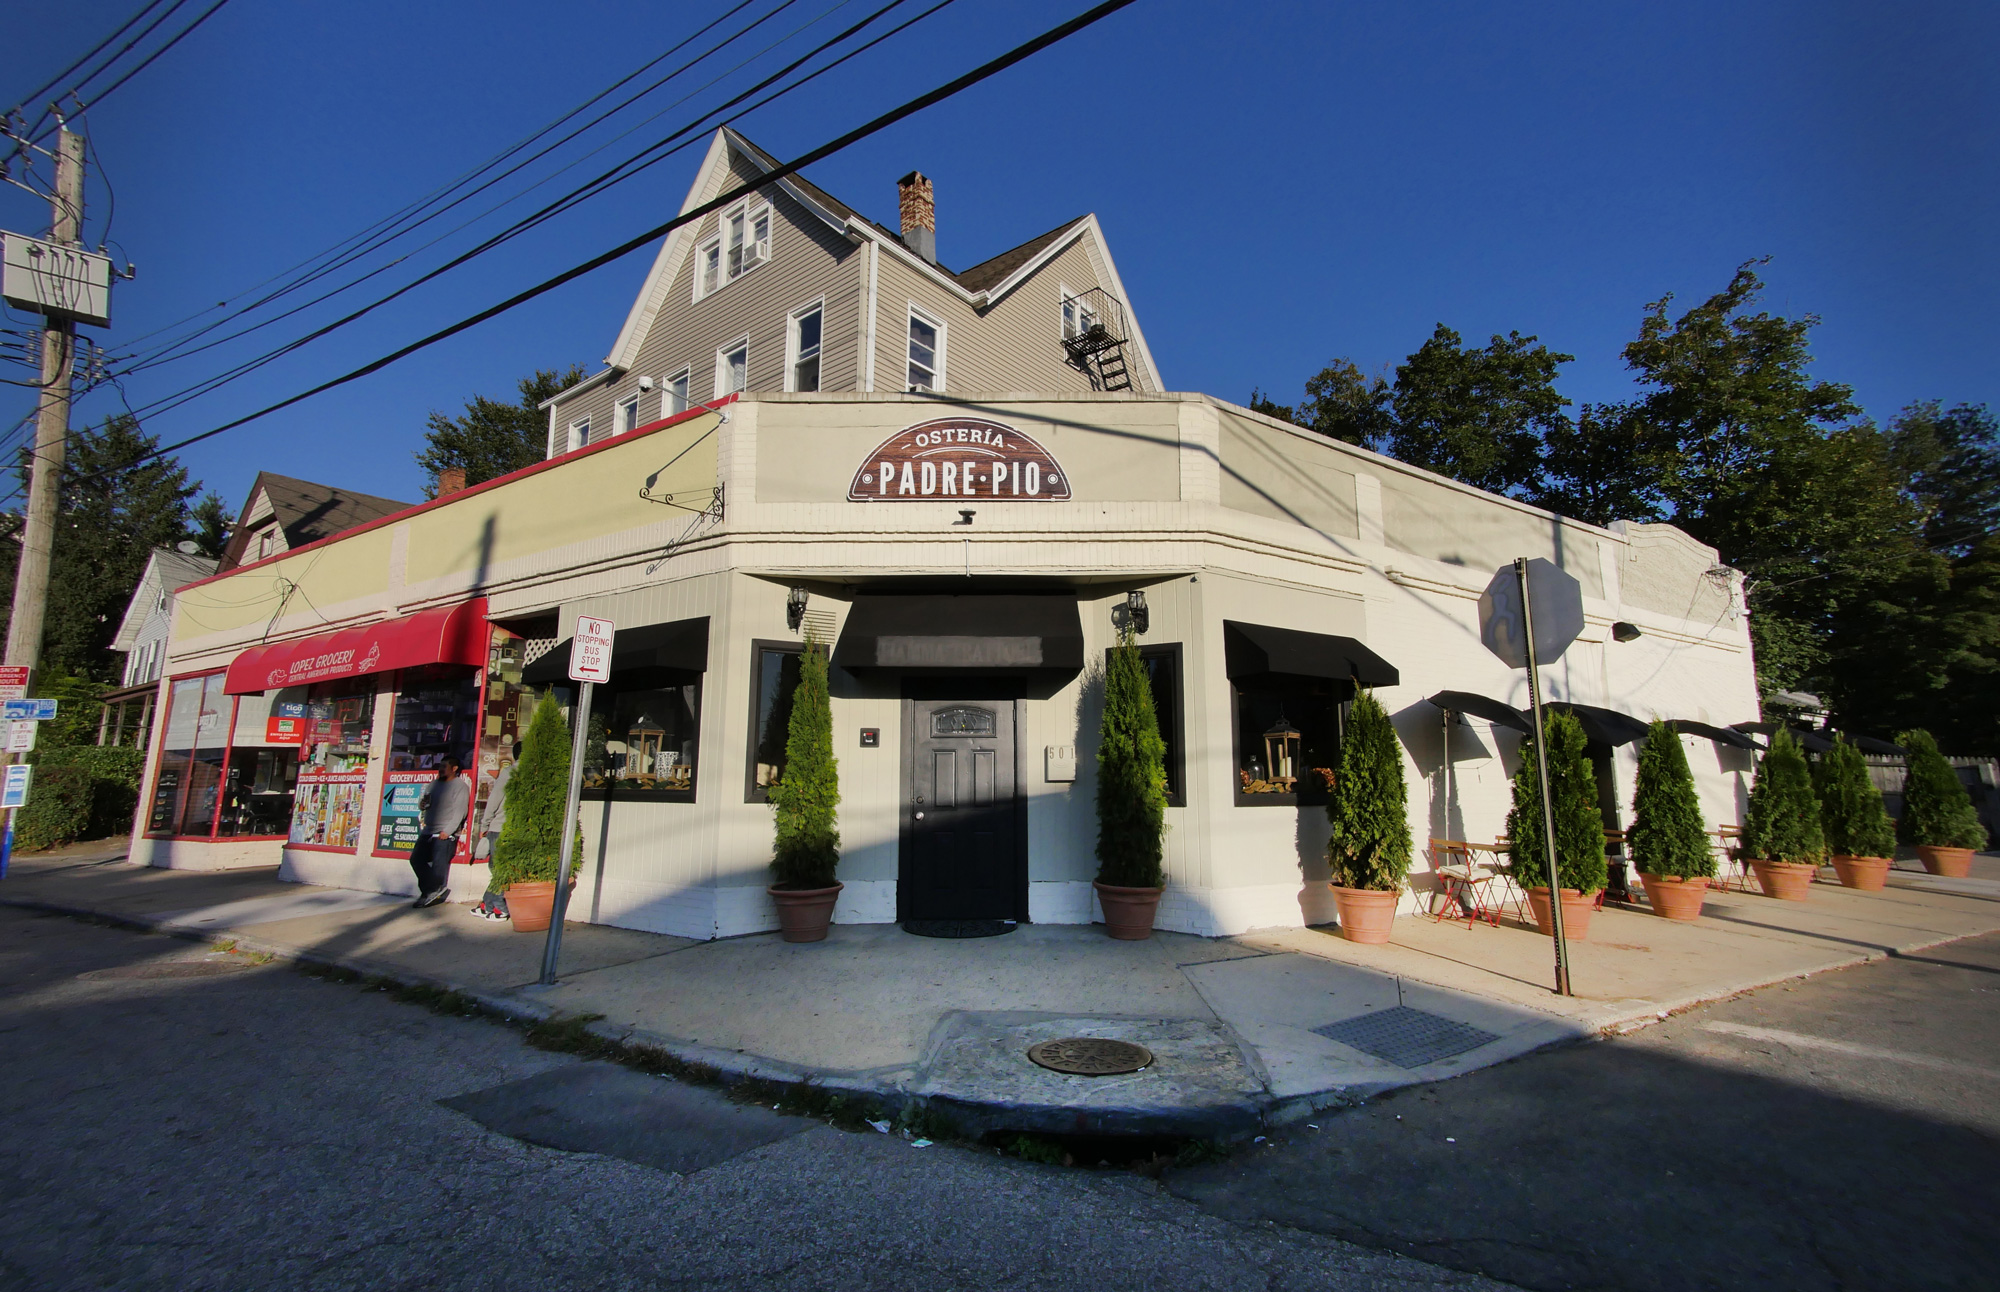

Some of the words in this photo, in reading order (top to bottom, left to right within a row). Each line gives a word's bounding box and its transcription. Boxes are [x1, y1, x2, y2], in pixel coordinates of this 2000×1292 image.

[915, 428, 1004, 449] OSTERÍA
[879, 461, 976, 496] PADRE
[992, 461, 1040, 496] PIO
[588, 622, 601, 635] NO
[577, 634, 610, 647] STOPPING
[584, 645, 600, 656] BUS
[289, 657, 316, 674] LOPEZ
[315, 649, 355, 668] GROCERY
[581, 655, 601, 665] STOP
[288, 672, 306, 683] CENTRAL
[306, 667, 329, 680] AMERICAN
[329, 663, 353, 675] PRODUCTS
[286, 703, 303, 714] tigo
[389, 774, 413, 783] GROCERY
[413, 773, 433, 782] LATINO
